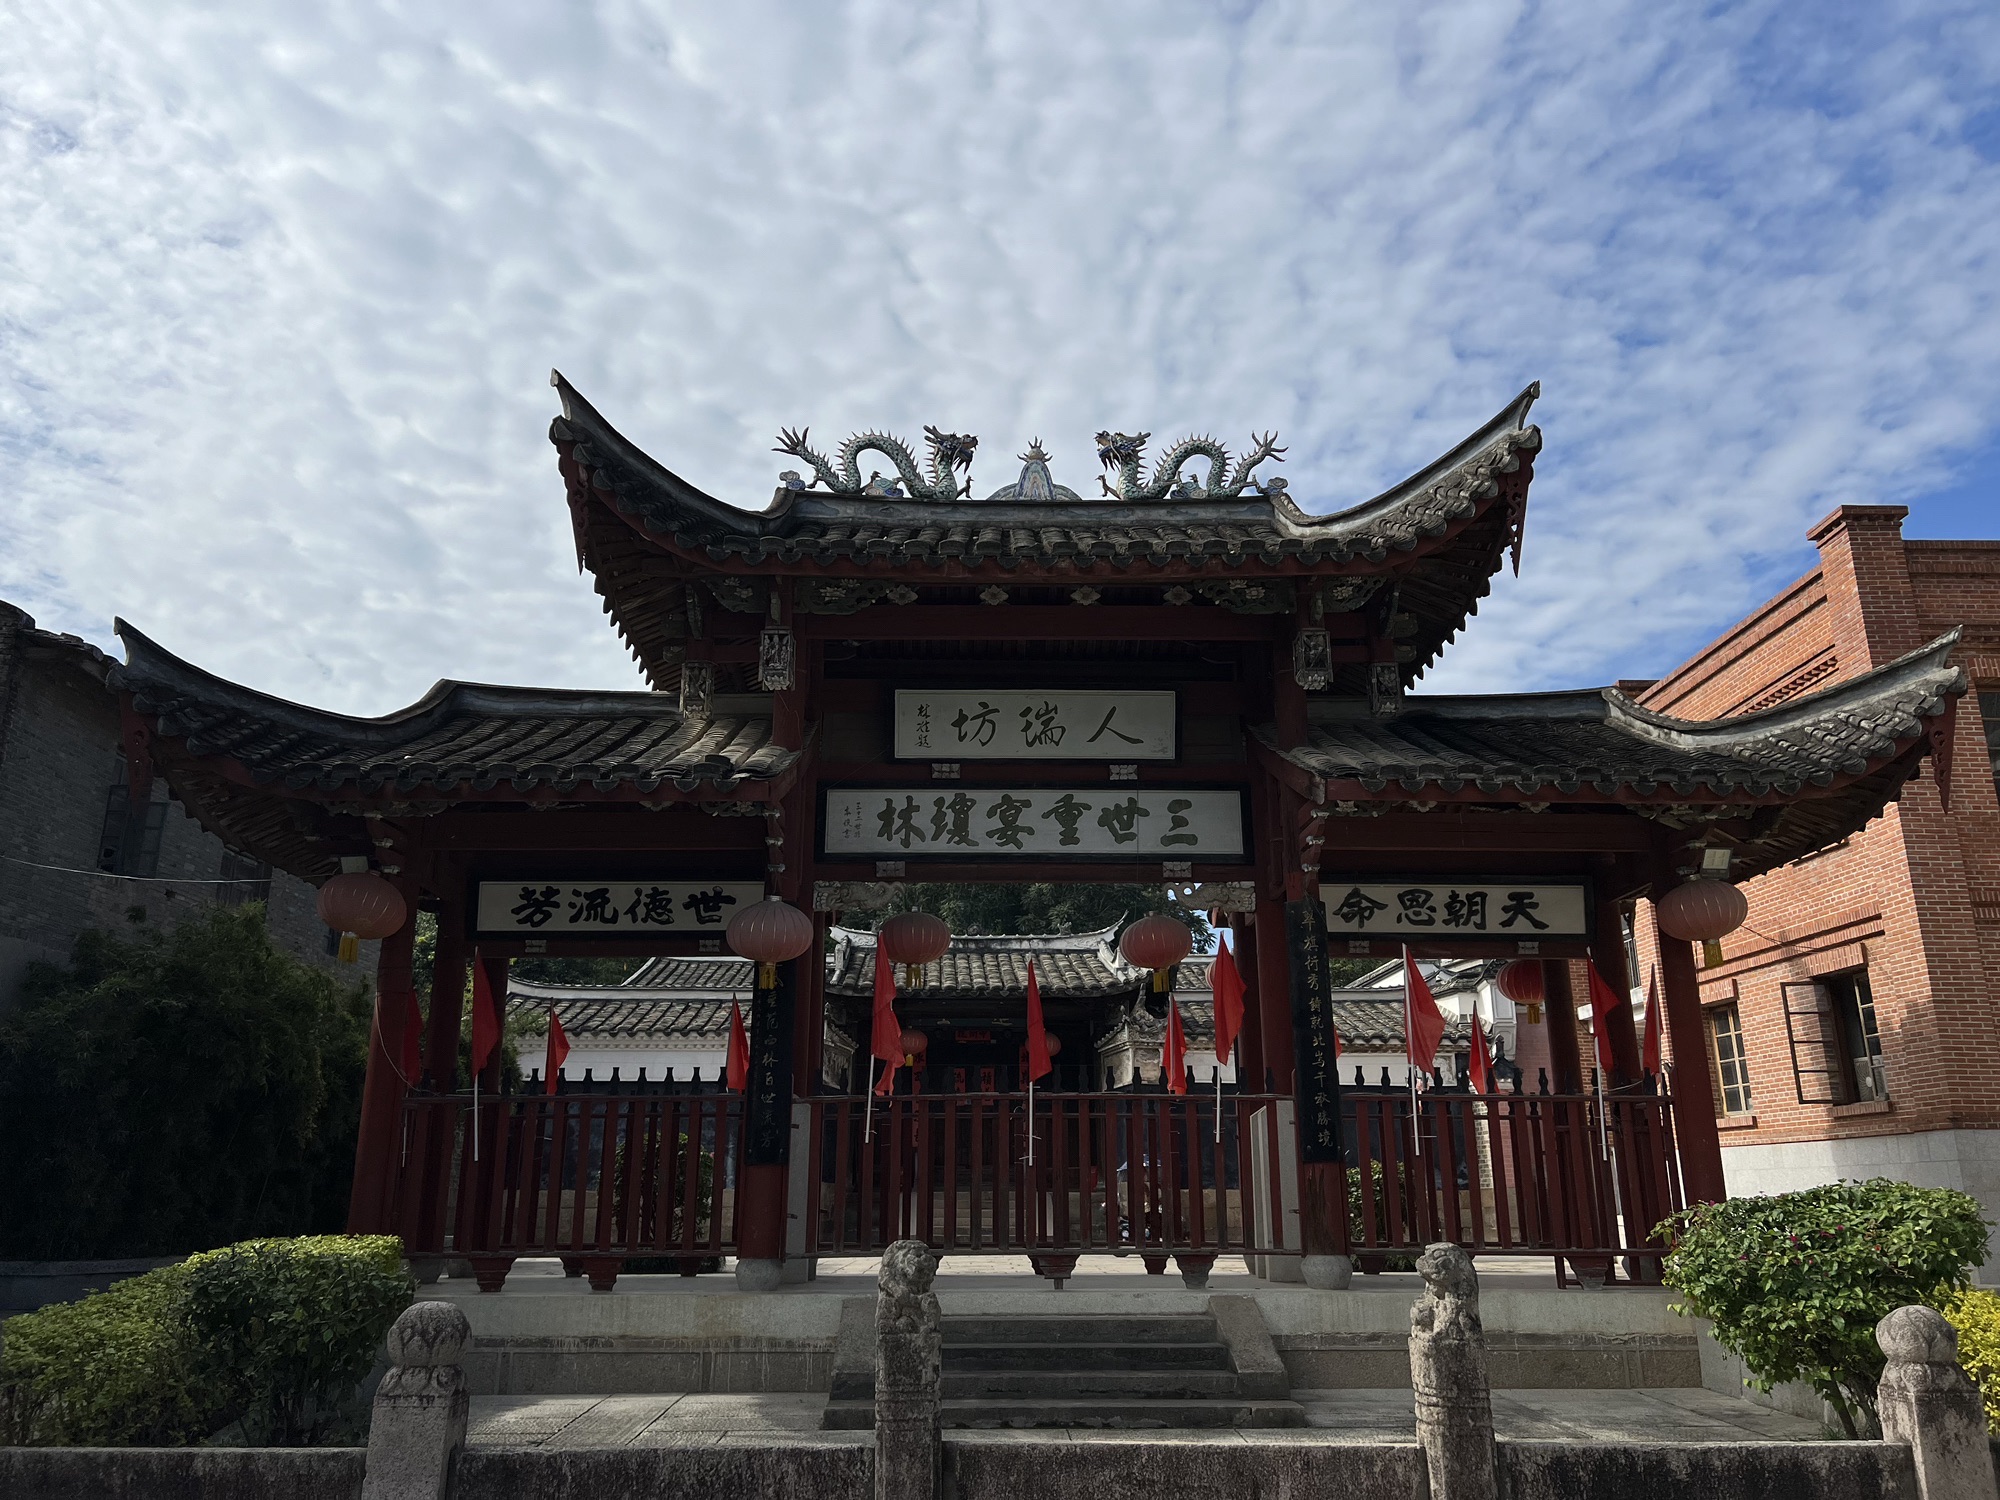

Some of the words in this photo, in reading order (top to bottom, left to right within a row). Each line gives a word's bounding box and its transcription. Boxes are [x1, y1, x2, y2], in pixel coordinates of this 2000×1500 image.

[950, 701, 1144, 748] 人瑞坊
[511, 886, 737, 928] 世德流芳
[1332, 887, 1550, 931] 天朝恩命
